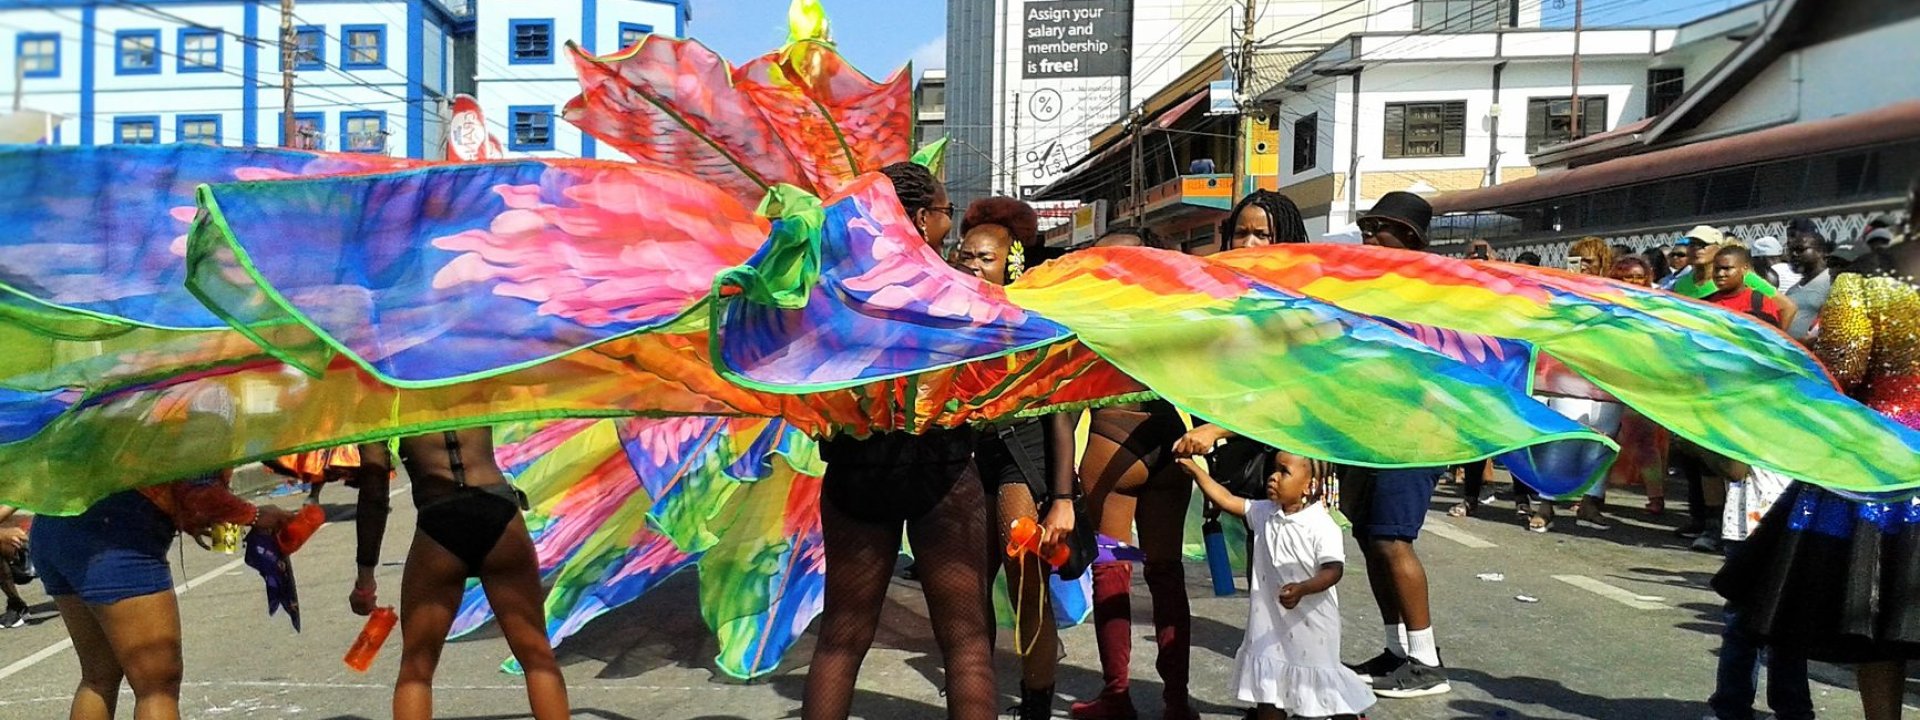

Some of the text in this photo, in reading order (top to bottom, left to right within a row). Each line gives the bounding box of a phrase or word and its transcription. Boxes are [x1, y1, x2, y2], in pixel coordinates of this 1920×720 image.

[1027, 6, 1104, 23] Assign your
[1027, 22, 1093, 39] salary and
[1027, 39, 1109, 55] membership
[1027, 58, 1079, 73] is free!
